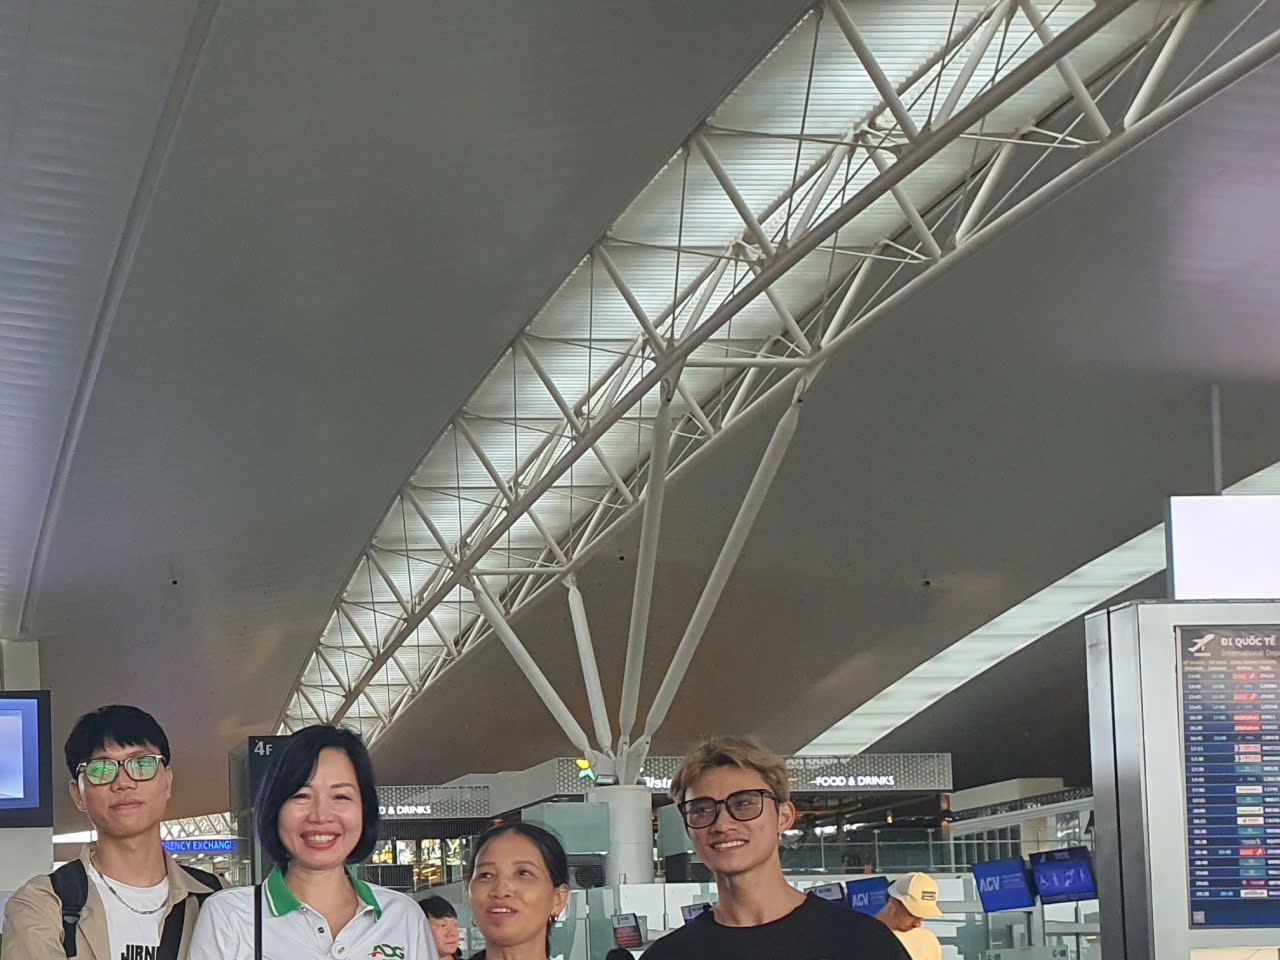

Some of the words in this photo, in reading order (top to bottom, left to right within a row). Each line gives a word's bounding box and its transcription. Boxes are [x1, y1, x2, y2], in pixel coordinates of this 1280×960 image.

[1235, 635, 1262, 648] QUỐC
[1264, 634, 1277, 646] TẾ
[254, 740, 273, 756] 4F
[816, 776, 846, 786] FOOD
[848, 776, 856, 786] &
[858, 776, 895, 786] DRINKS
[388, 806, 395, 815] &
[397, 805, 432, 815] DRINKS
[161, 841, 191, 851] RENCY
